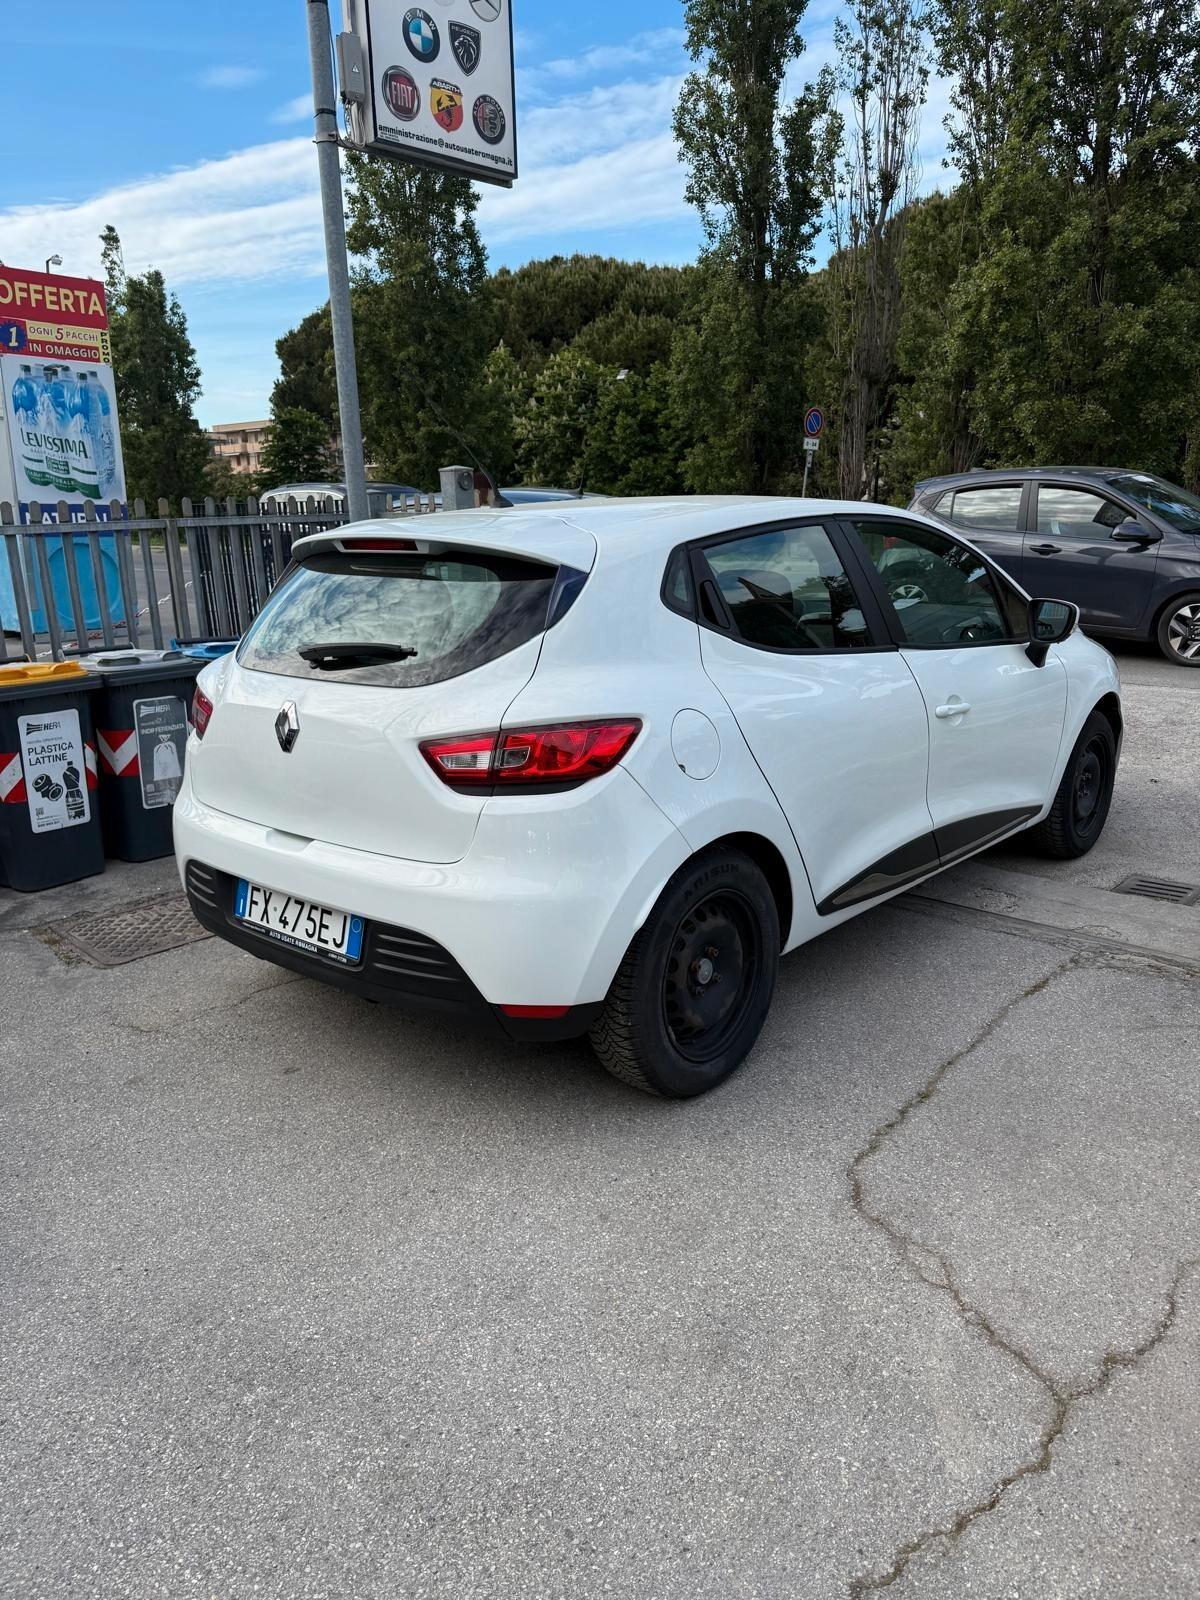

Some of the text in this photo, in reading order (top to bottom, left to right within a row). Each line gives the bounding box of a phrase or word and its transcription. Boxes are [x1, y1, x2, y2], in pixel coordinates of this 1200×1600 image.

[405, 9, 436, 31] BMW
[451, 25, 479, 37] PEUGEOT
[391, 81, 414, 109] FIAT
[432, 80, 461, 94] ABARTH
[378, 123, 513, 167] amministrazione@autousateromagna.it
[0, 279, 105, 317] OFFERTA
[8, 326, 18, 347] 1
[29, 326, 98, 342] OGNI 5 PACCHI
[29, 342, 99, 359] IN OMAGGIO
[100, 331, 110, 363] PROMO
[20, 428, 89, 459] LEVISSIMA
[28, 741, 74, 756] PLASTICA
[28, 752, 68, 766] LATTINE
[269, 930, 318, 953] AUTO USATE ROMAGNA
